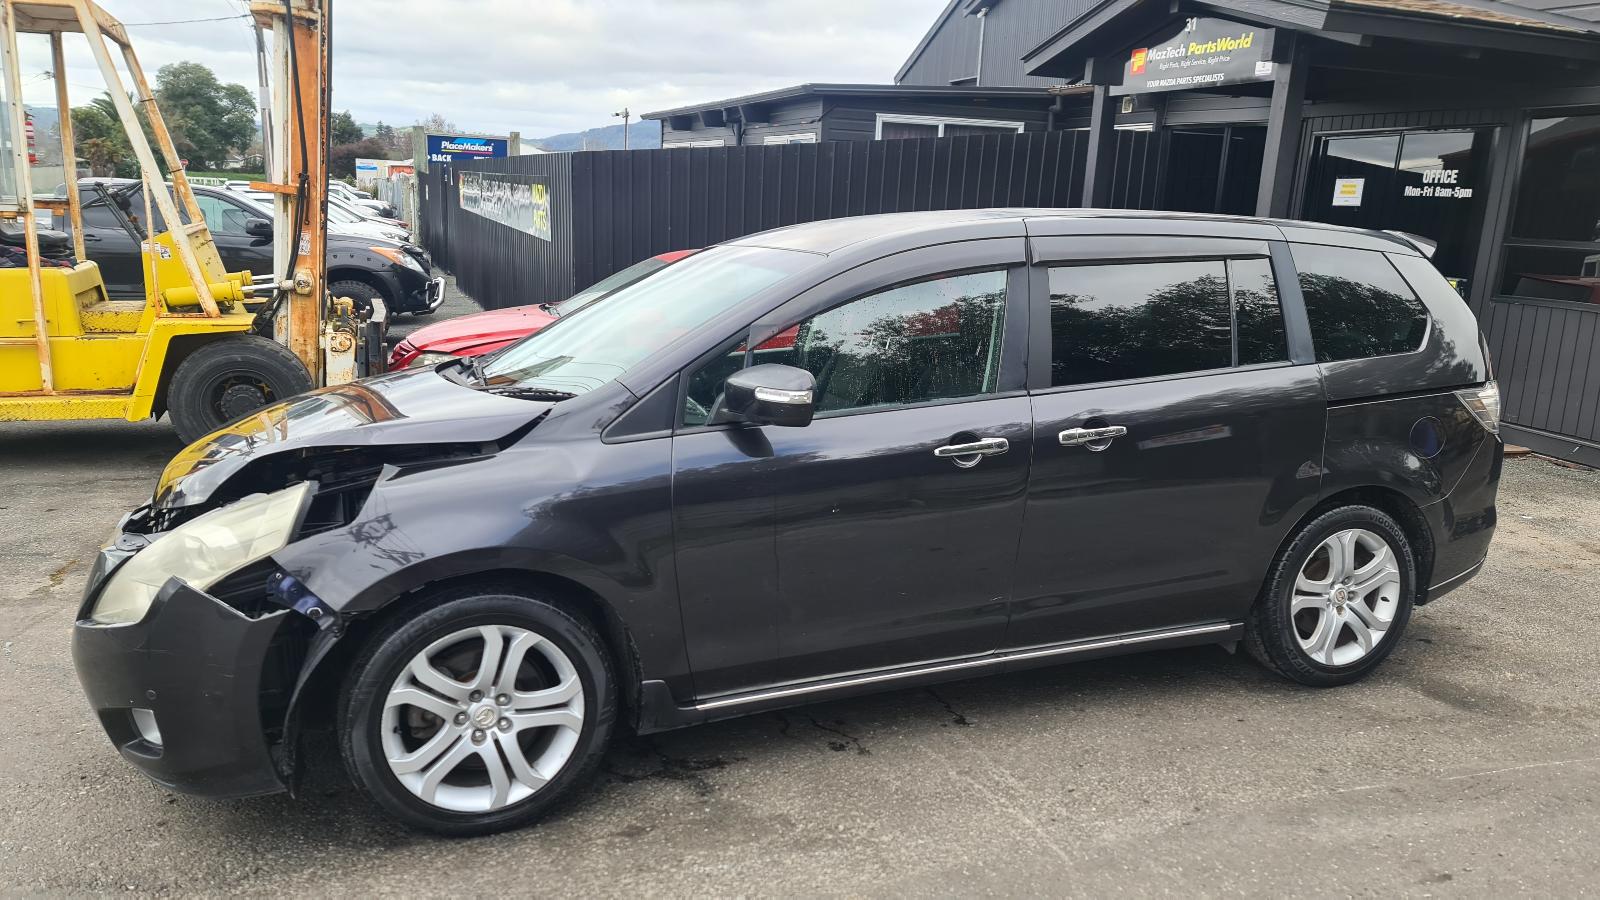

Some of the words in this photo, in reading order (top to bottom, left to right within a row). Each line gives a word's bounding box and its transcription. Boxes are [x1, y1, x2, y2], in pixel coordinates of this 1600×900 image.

[1185, 17, 1197, 32] 31
[1147, 44, 1186, 60] MazTech
[1187, 32, 1254, 55] PartsWorld
[1146, 79, 1159, 88] YOUR
[1159, 78, 1176, 87] MAZDA
[1176, 76, 1192, 85] PARTS
[1192, 73, 1224, 84] SPECIALISTS
[441, 141, 493, 152] PlaceMakers
[432, 154, 452, 162] BACK
[1422, 169, 1459, 184] OFFICE
[1404, 186, 1434, 197] Mon-Fri
[1434, 186, 1473, 198] 8am-5pm
[1370, 512, 1408, 549] VIGOROUS
